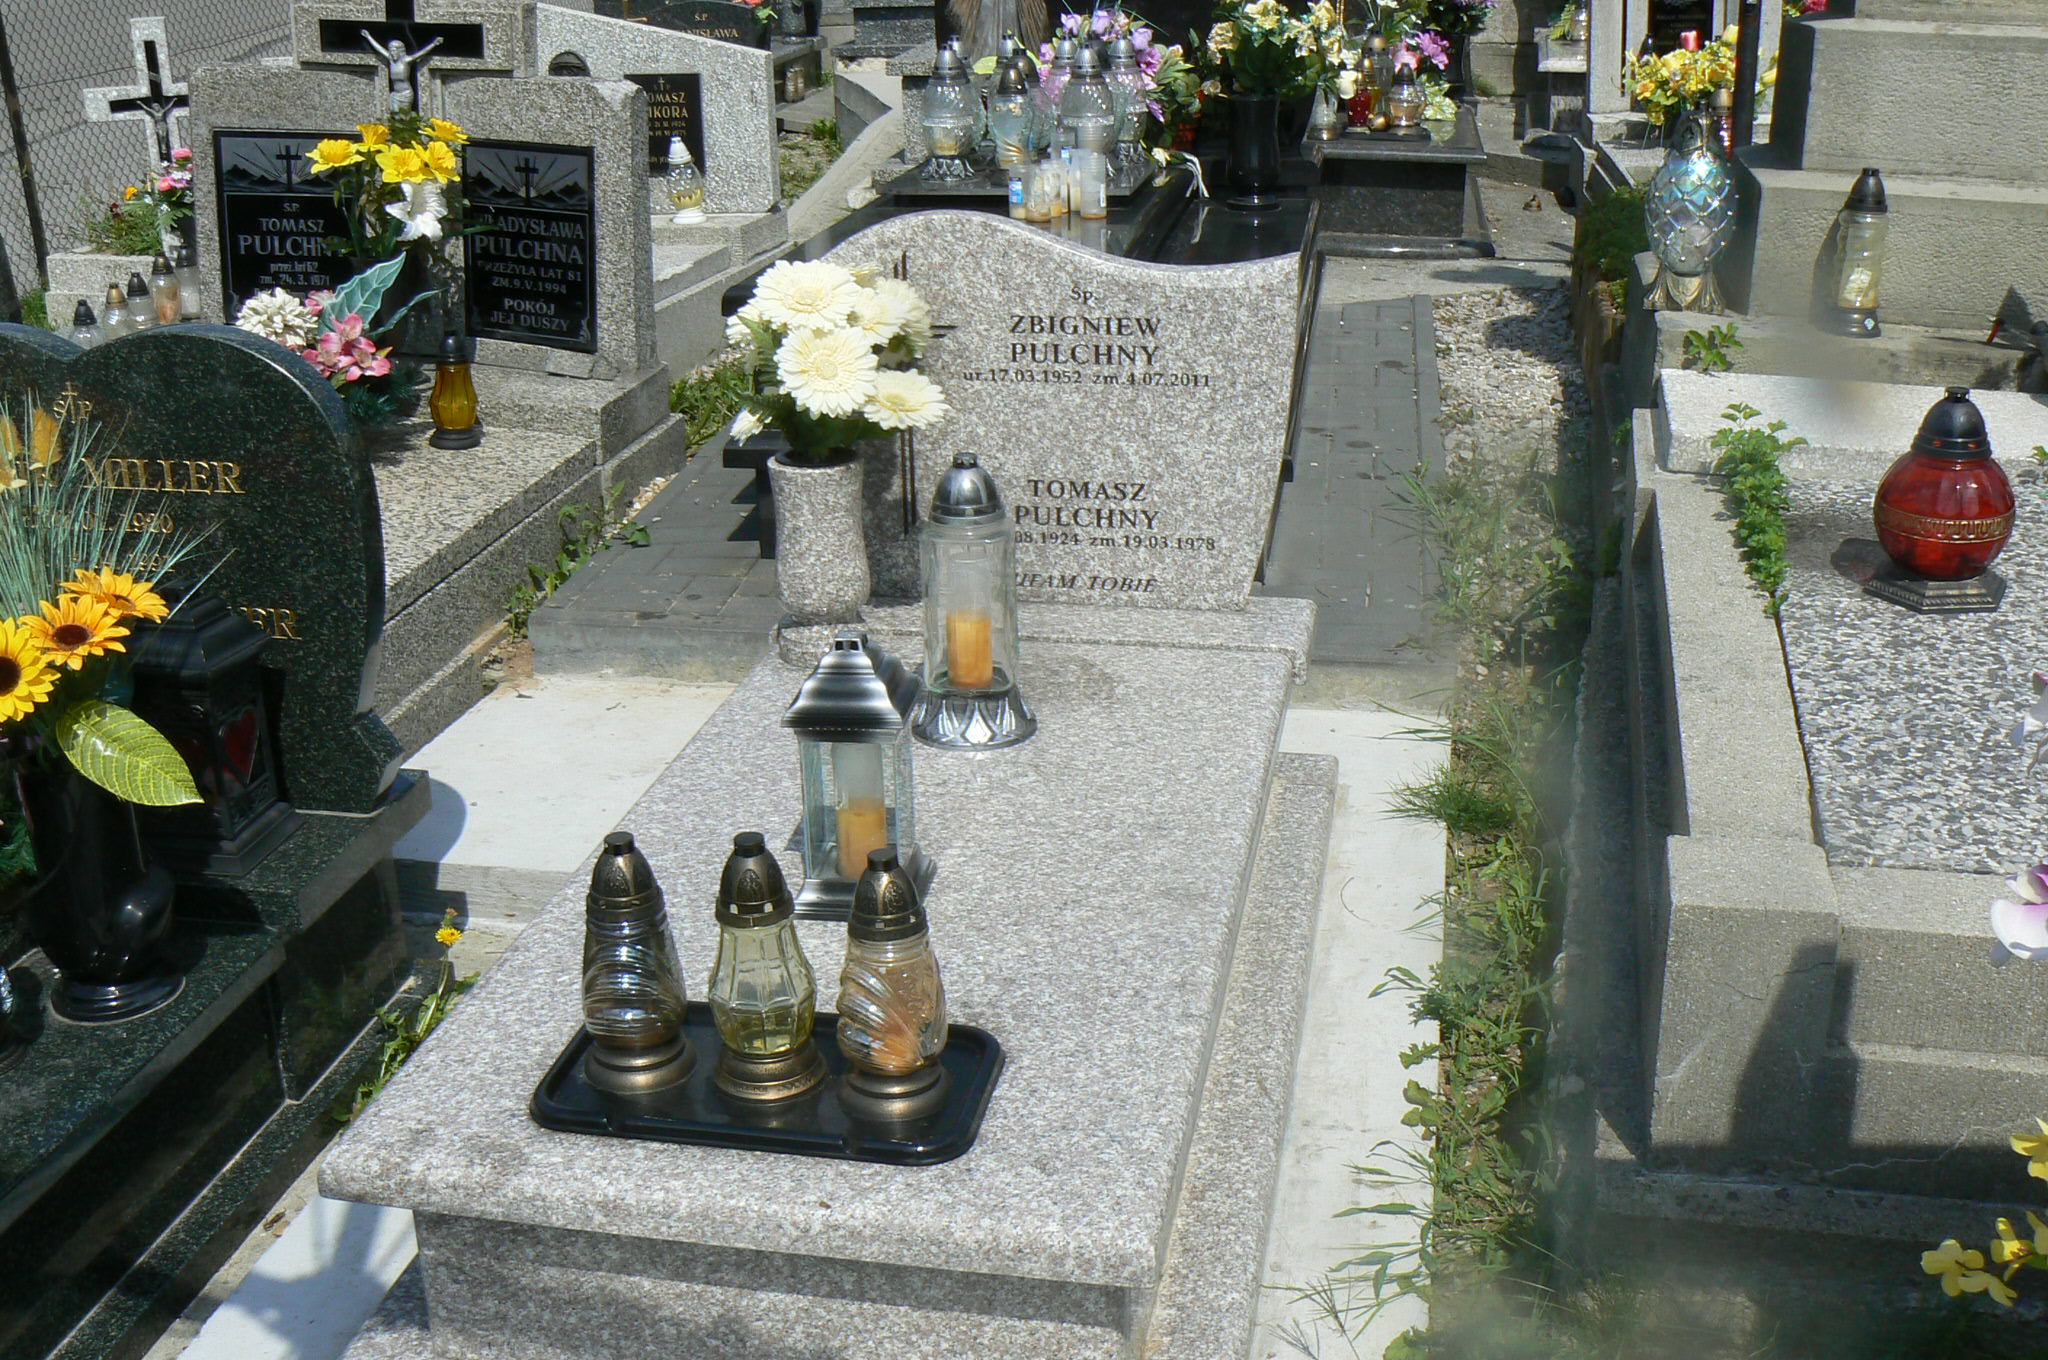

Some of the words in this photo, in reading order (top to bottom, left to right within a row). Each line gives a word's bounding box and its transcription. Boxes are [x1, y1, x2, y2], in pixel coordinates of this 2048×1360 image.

[648, 91, 687, 104] OMASZ
[648, 105, 689, 119] IKORA
[259, 218, 325, 233] TOMASZ
[238, 235, 345, 258] PULCHN
[474, 235, 584, 265] PULCHNA
[541, 267, 563, 280] LAT
[568, 271, 582, 282] 81
[504, 297, 555, 316] POKÓJ
[490, 311, 515, 325] JEJ
[521, 315, 570, 332] DUSZY
[1010, 315, 1162, 338] ZBIGNIEW
[1011, 343, 1161, 366] PULCHNY
[80, 457, 247, 496] MILLER
[1027, 479, 1148, 501] TOMASZ
[1014, 505, 1160, 531] PULCHNY
[1086, 576, 1160, 593] TOBIE
